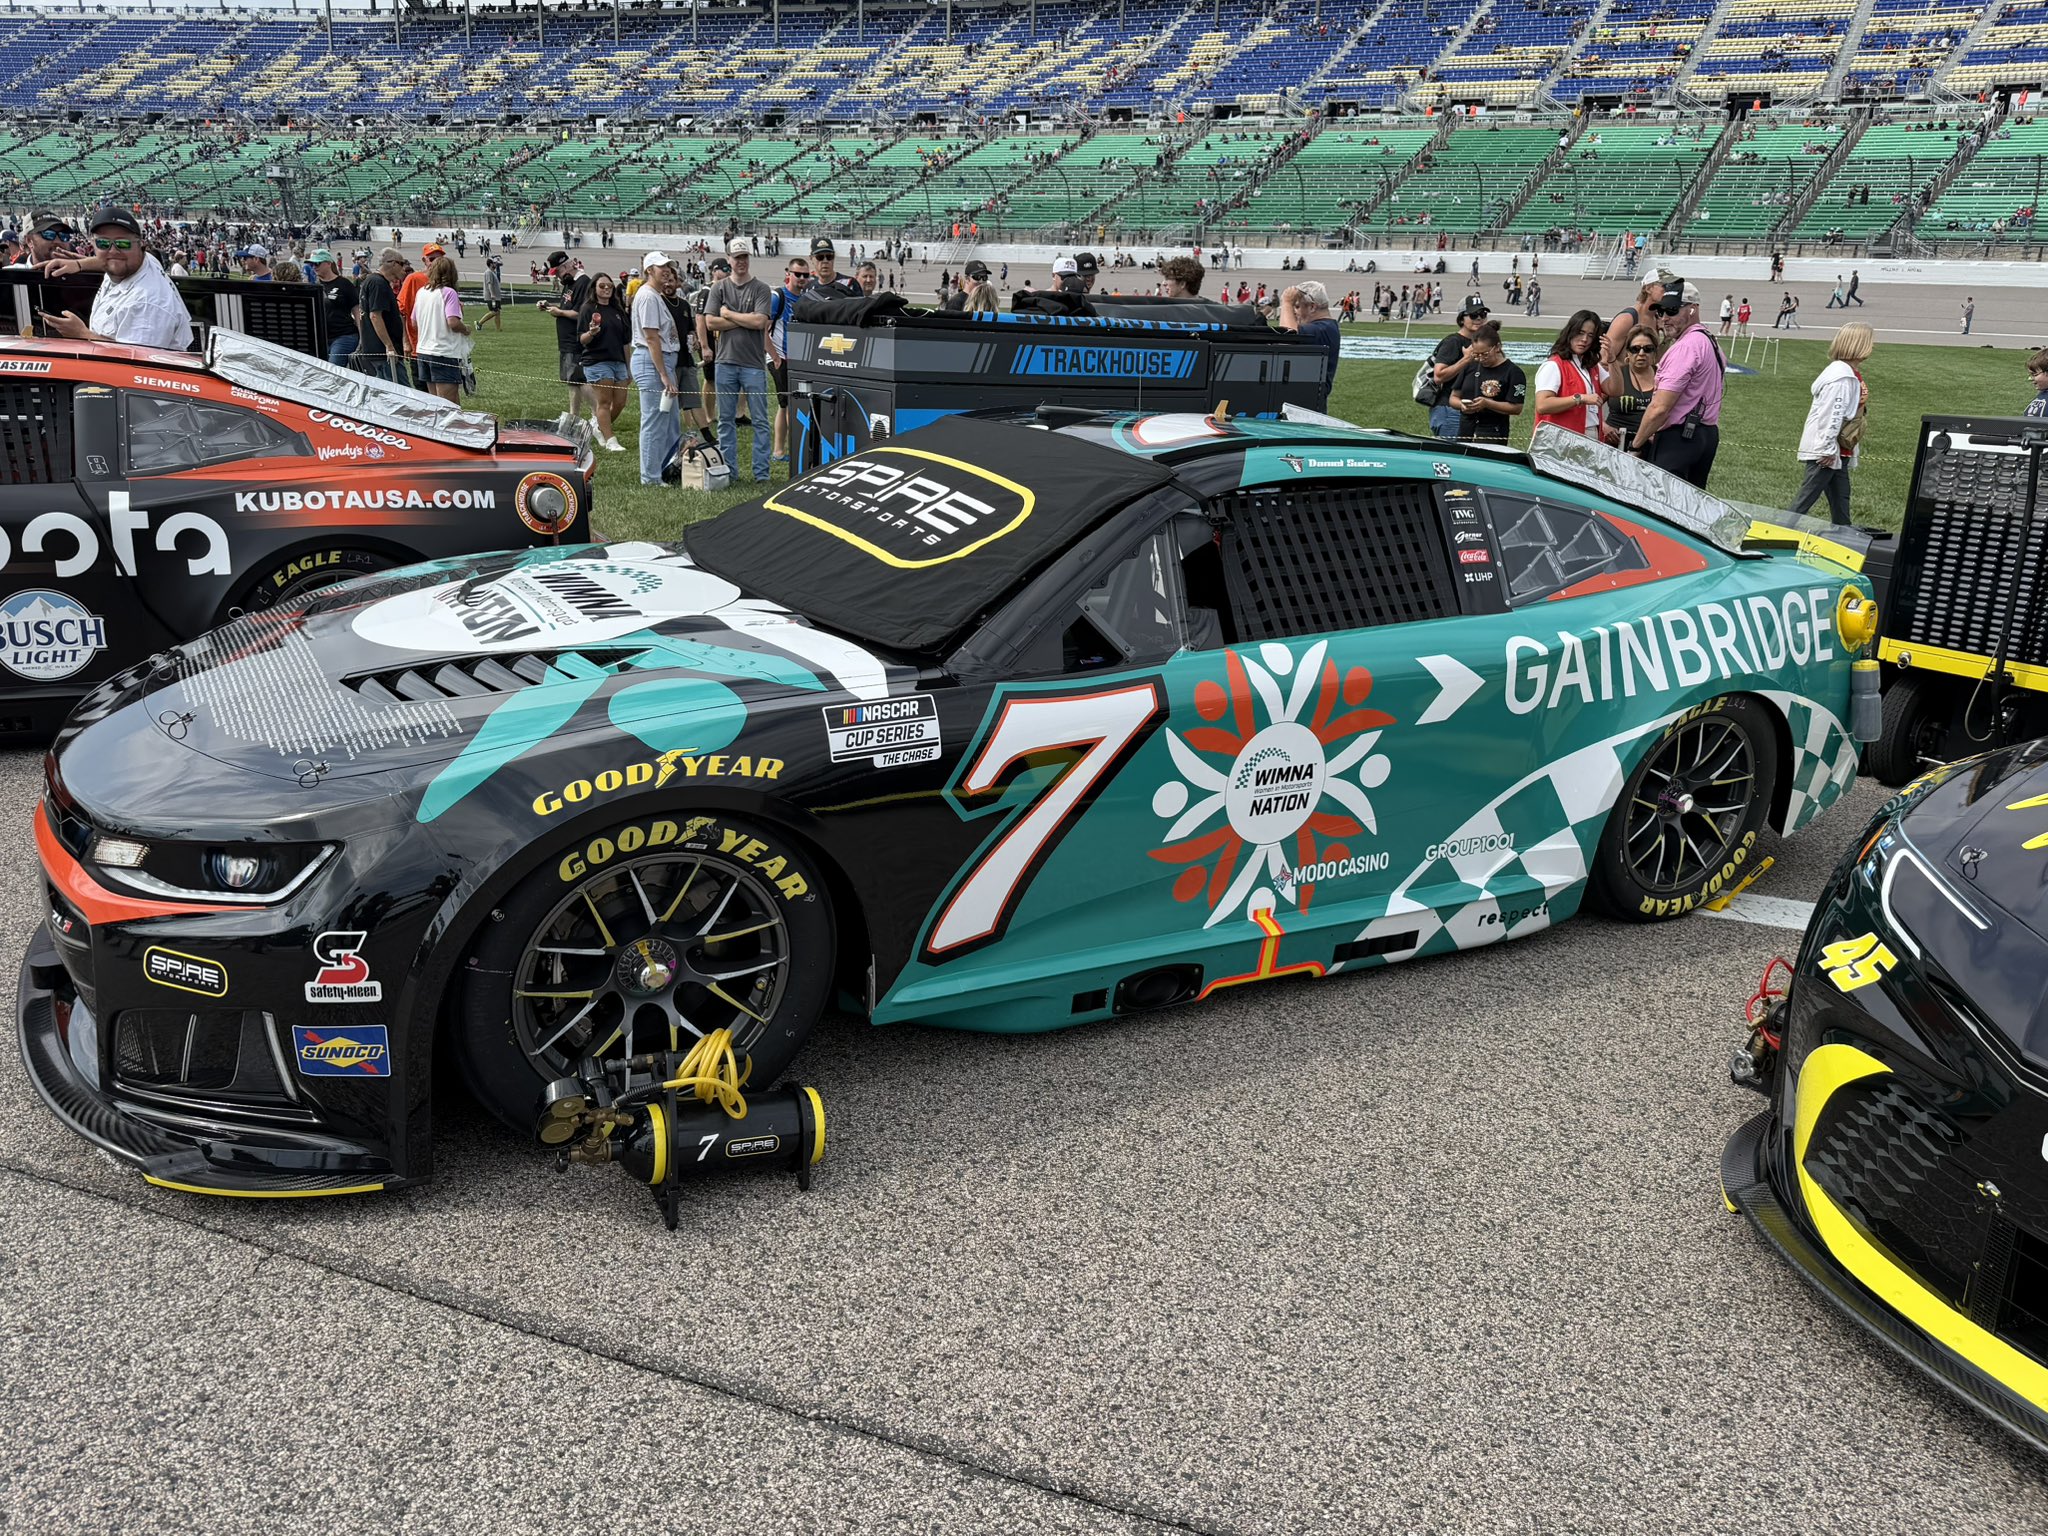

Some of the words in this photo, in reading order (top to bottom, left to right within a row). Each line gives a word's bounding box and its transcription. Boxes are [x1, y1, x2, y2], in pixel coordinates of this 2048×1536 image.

[0, 361, 49, 371] ASTAIN
[818, 358, 858, 369] CHEVROLET
[1040, 347, 1172, 375] TRACKHOUSE
[133, 375, 200, 393] SIEMENS
[231, 390, 280, 406] CREAFORM
[317, 443, 363, 461] Wendy's
[235, 490, 496, 512] KUBOTAUSA.COM
[811, 460, 996, 535] SPIRE
[1452, 509, 1475, 519] TWG
[0, 491, 232, 577] ota
[272, 550, 342, 588] EAGLE
[1474, 572, 1493, 582] UHP
[532, 572, 642, 623] WIMNA
[0, 618, 105, 650] USCH
[12, 649, 81, 665] LIGHT
[1504, 587, 1833, 715] GAINBRIDGE
[862, 701, 919, 722] NASCAR
[1664, 697, 1728, 741] EAGLE
[845, 730, 874, 748] CUP
[876, 724, 925, 744] SERIES
[882, 752, 901, 765] THE
[902, 748, 934, 763] CHASE
[1254, 763, 1314, 787] WIMNA
[1249, 792, 1310, 817] NATION
[926, 683, 1159, 954] 7
[1292, 859, 1337, 885] MODO
[1338, 851, 1390, 877] CASINO
[1477, 899, 1550, 927] respect
[151, 954, 219, 984] SPIRE
[1817, 931, 1899, 993] 45
[304, 1045, 382, 1059] SUNOCO
[697, 1133, 719, 1161] 7
[731, 1139, 774, 1151] SPIRE
